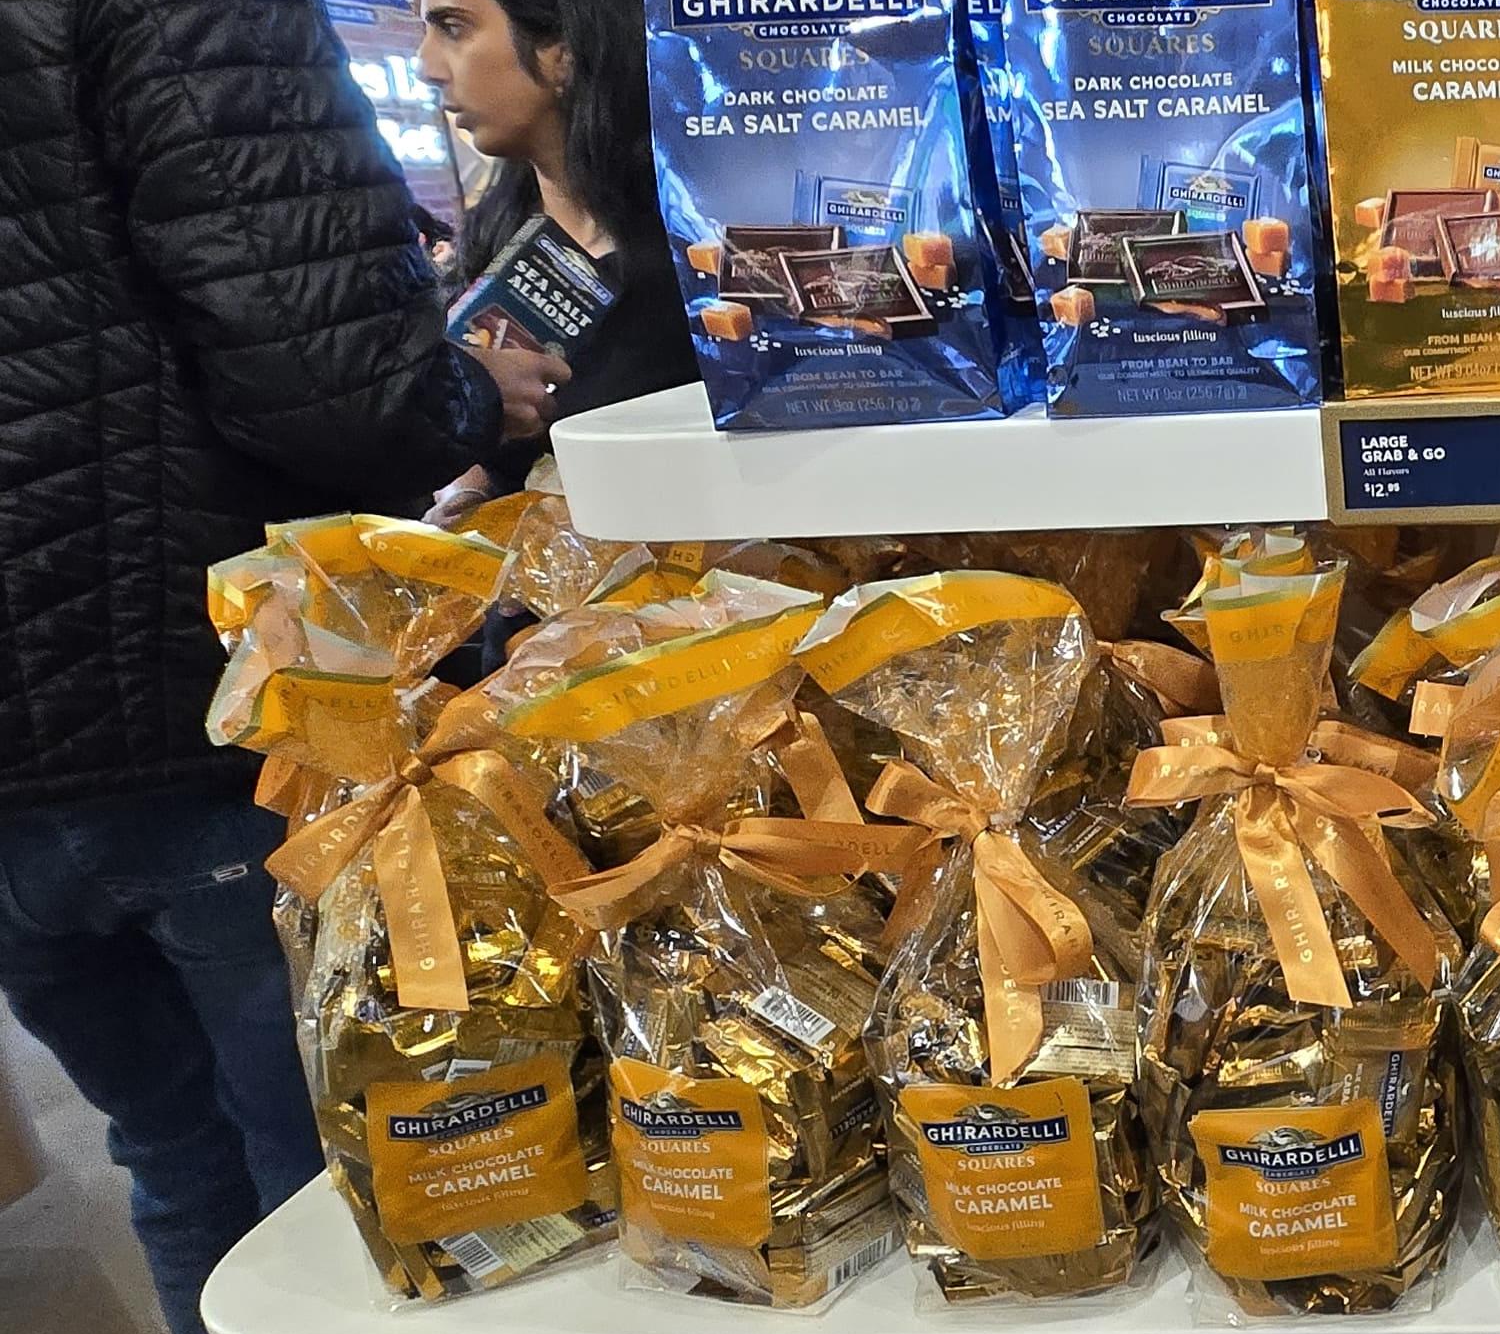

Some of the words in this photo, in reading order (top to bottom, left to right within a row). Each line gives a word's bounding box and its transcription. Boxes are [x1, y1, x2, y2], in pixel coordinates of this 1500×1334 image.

[1108, 12, 1191, 23] CHOCOLATE
[759, 23, 846, 36] CHOCOLATE
[1089, 33, 1215, 59] SQUARES
[740, 46, 870, 73] SQUARES
[1393, 60, 1433, 74] MILK
[1075, 77, 1122, 91] DARK
[1130, 72, 1232, 89] CHOCOLATE
[724, 90, 775, 106] DARK
[783, 85, 887, 104] CHOCOLATE
[1044, 100, 1085, 121] SEA
[1094, 99, 1148, 119] SALT
[1158, 94, 1270, 116] CARAMEL
[686, 115, 734, 136] SEA
[744, 114, 801, 134] SALT
[812, 107, 927, 131] CARAMEL
[1172, 189, 1244, 208] GHIRARDELLI
[829, 204, 904, 221] GHIRARDELLI
[513, 259, 549, 291] SEA
[550, 290, 592, 327] SALT
[507, 274, 580, 337] ALMOND
[1442, 308, 1486, 318] luscious
[1134, 332, 1180, 343] luscious
[1182, 330, 1217, 343] filling
[1428, 335, 1459, 345] FROM
[1464, 334, 1493, 343] BEAN
[794, 345, 844, 357] luscious
[846, 344, 882, 357] filling
[1121, 359, 1153, 369] FROM
[1158, 358, 1188, 368] BEAN
[1192, 358, 1206, 367] TO
[1212, 357, 1233, 366] BAR
[1117, 390, 1139, 403] NET
[1361, 435, 1408, 449] LARGE
[1362, 450, 1403, 463] GRAB
[1408, 448, 1418, 461] &
[1423, 447, 1445, 460] GO
[394, 1089, 543, 1135] GHIRARDELLI
[623, 1104, 735, 1126] GHIRARDELLI
[428, 1126, 515, 1156] SQUARES
[927, 1122, 1061, 1141] GHIRARDELLI
[640, 1141, 711, 1153] SQUARES
[1226, 1139, 1356, 1166] GHIRARDELLI
[408, 1168, 447, 1185] MILK
[451, 1144, 545, 1174] CHOCOLATE
[958, 1156, 1035, 1172] SQUARES
[425, 1164, 537, 1198] CARAMEL
[642, 1175, 723, 1200] CARAMEL
[976, 1178, 1062, 1195] CHOCOLATE
[1256, 1177, 1331, 1196] SQUARES
[955, 1195, 1053, 1215] CARAMEL
[1239, 1202, 1268, 1218] MILK
[1272, 1195, 1357, 1218] CHOCOLATE
[1249, 1212, 1348, 1238] CARAMEL
